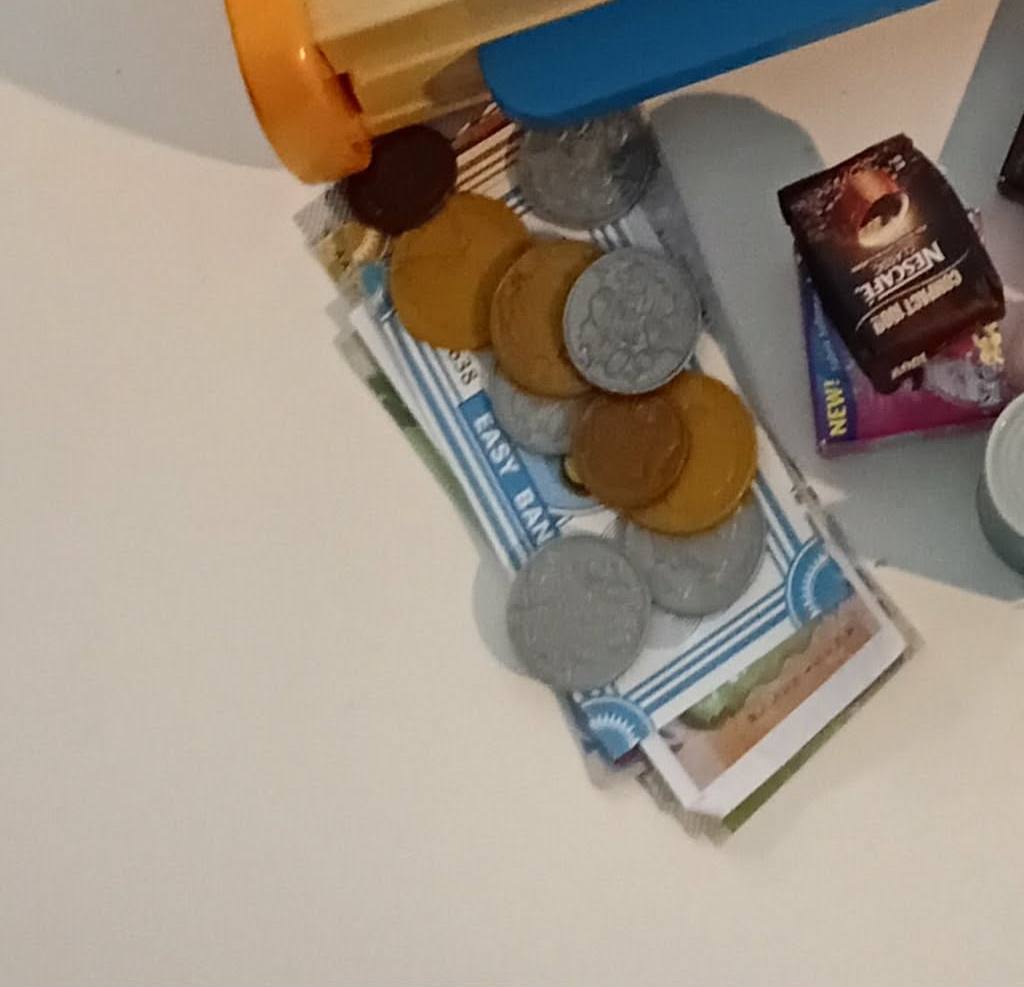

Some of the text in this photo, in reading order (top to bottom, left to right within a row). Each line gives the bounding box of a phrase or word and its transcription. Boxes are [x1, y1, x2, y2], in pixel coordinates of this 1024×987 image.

[823, 378, 848, 438] NEW!
[474, 411, 554, 547] EASY BAN
